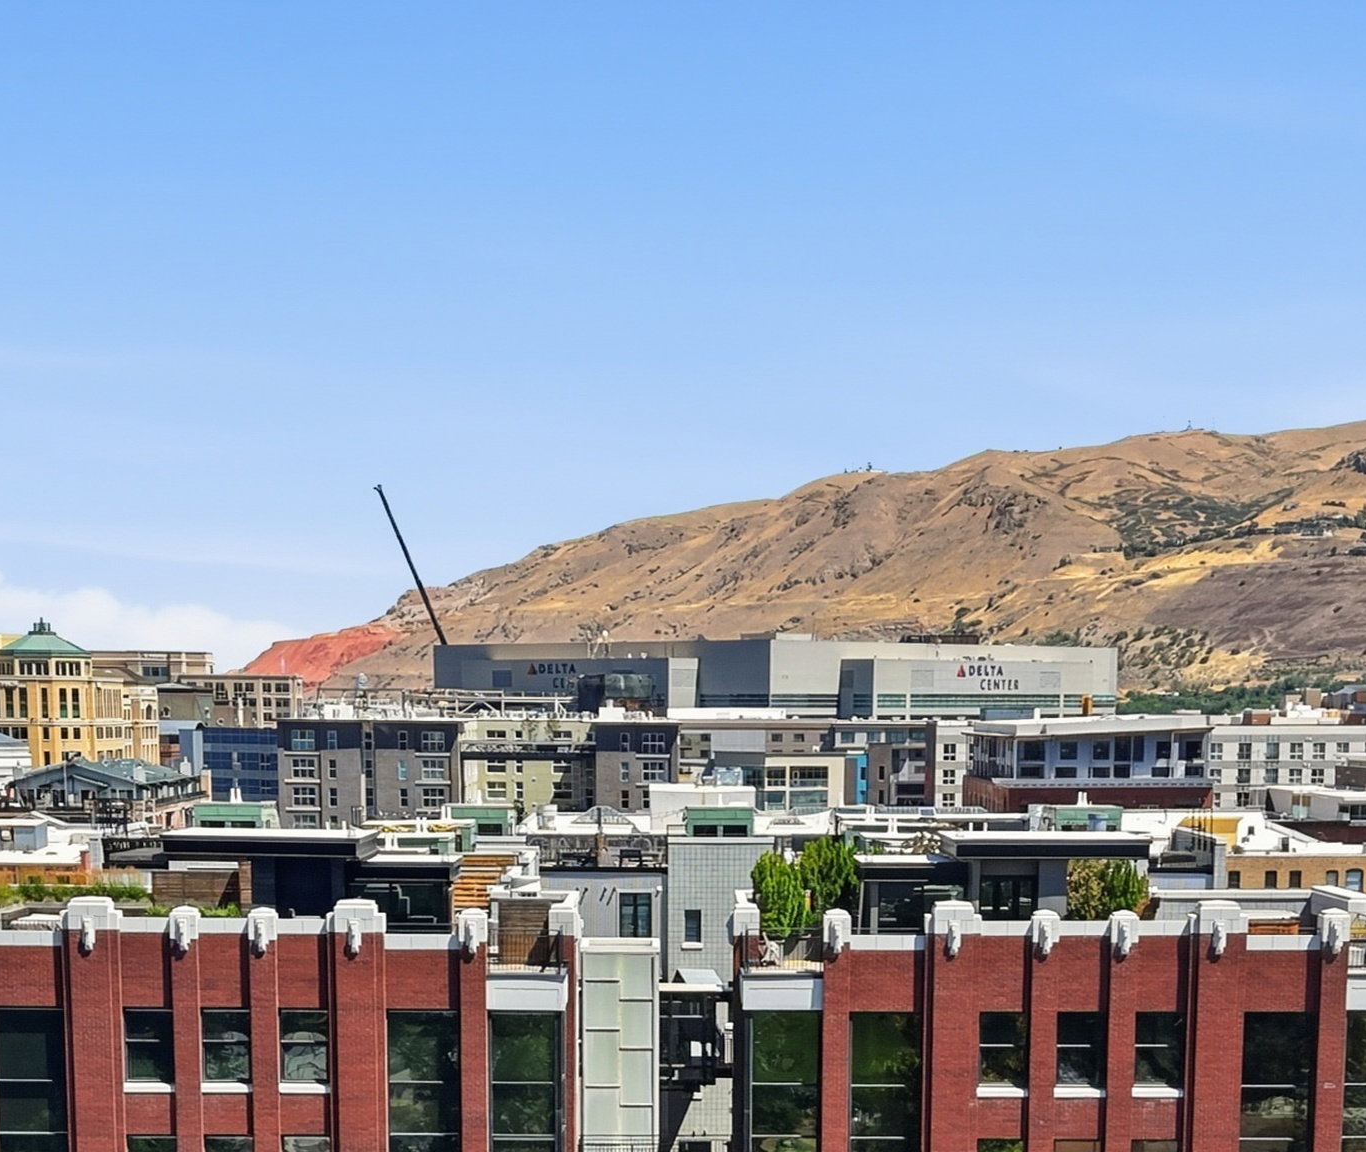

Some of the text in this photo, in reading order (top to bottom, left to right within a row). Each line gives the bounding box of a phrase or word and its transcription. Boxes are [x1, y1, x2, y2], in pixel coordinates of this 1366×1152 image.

[538, 663, 577, 674] DELTA
[968, 665, 1004, 677] DELTA
[979, 679, 1019, 691] CENTER
